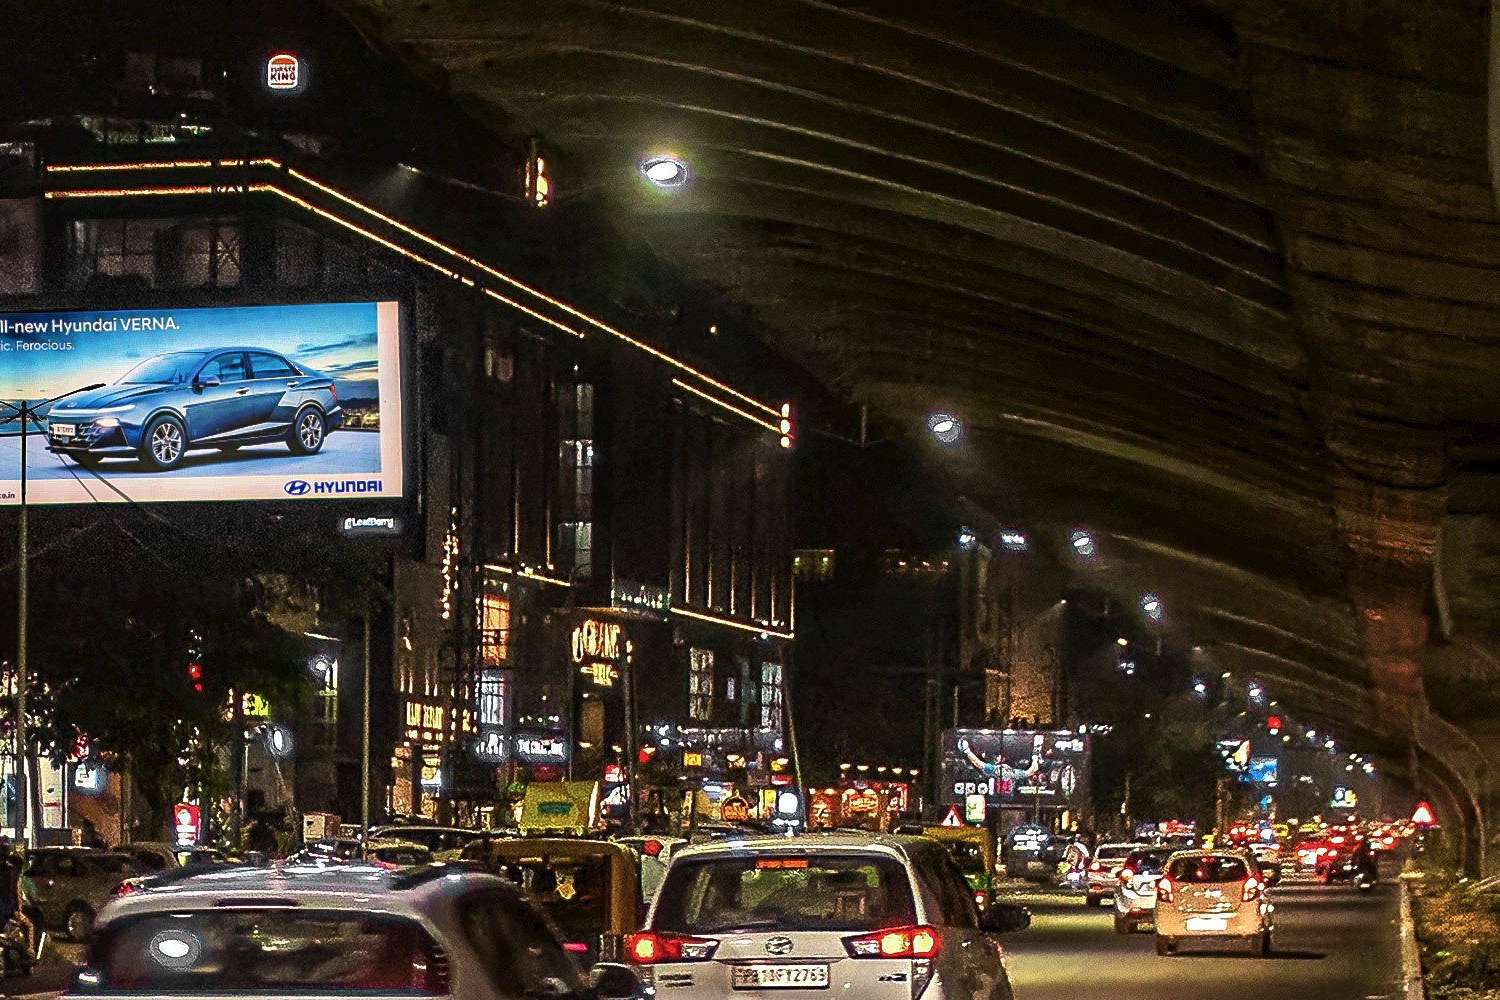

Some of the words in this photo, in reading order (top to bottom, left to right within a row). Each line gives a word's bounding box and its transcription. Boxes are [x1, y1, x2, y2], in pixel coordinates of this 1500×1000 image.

[270, 72, 296, 81] KING
[52, 317, 117, 336] Hyundai
[120, 316, 181, 331] VERNA.
[16, 339, 75, 351] Ferocious.
[314, 480, 383, 494] HYUNDAI
